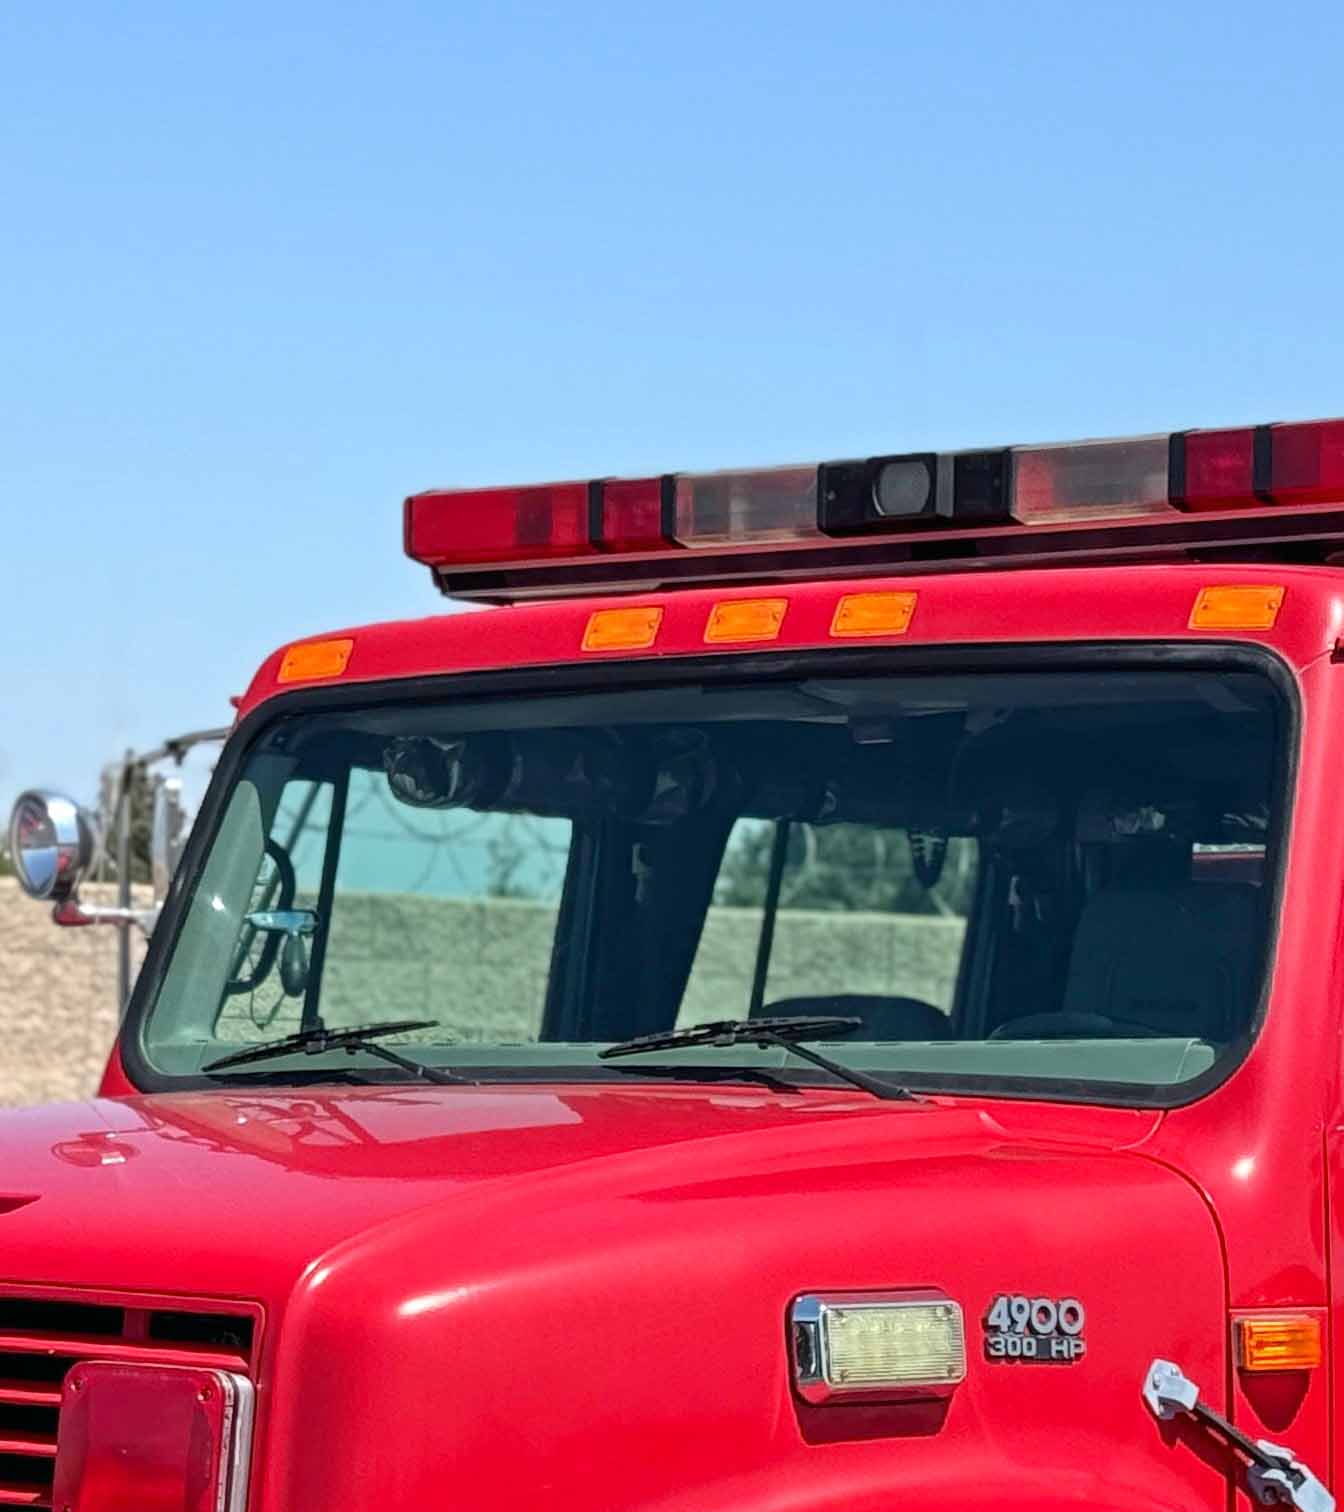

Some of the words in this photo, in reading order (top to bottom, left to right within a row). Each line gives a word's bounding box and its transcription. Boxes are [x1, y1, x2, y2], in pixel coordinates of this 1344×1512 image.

[985, 1295, 1085, 1335] 4900
[988, 1336, 1037, 1357] 300
[1050, 1338, 1087, 1359] HP
